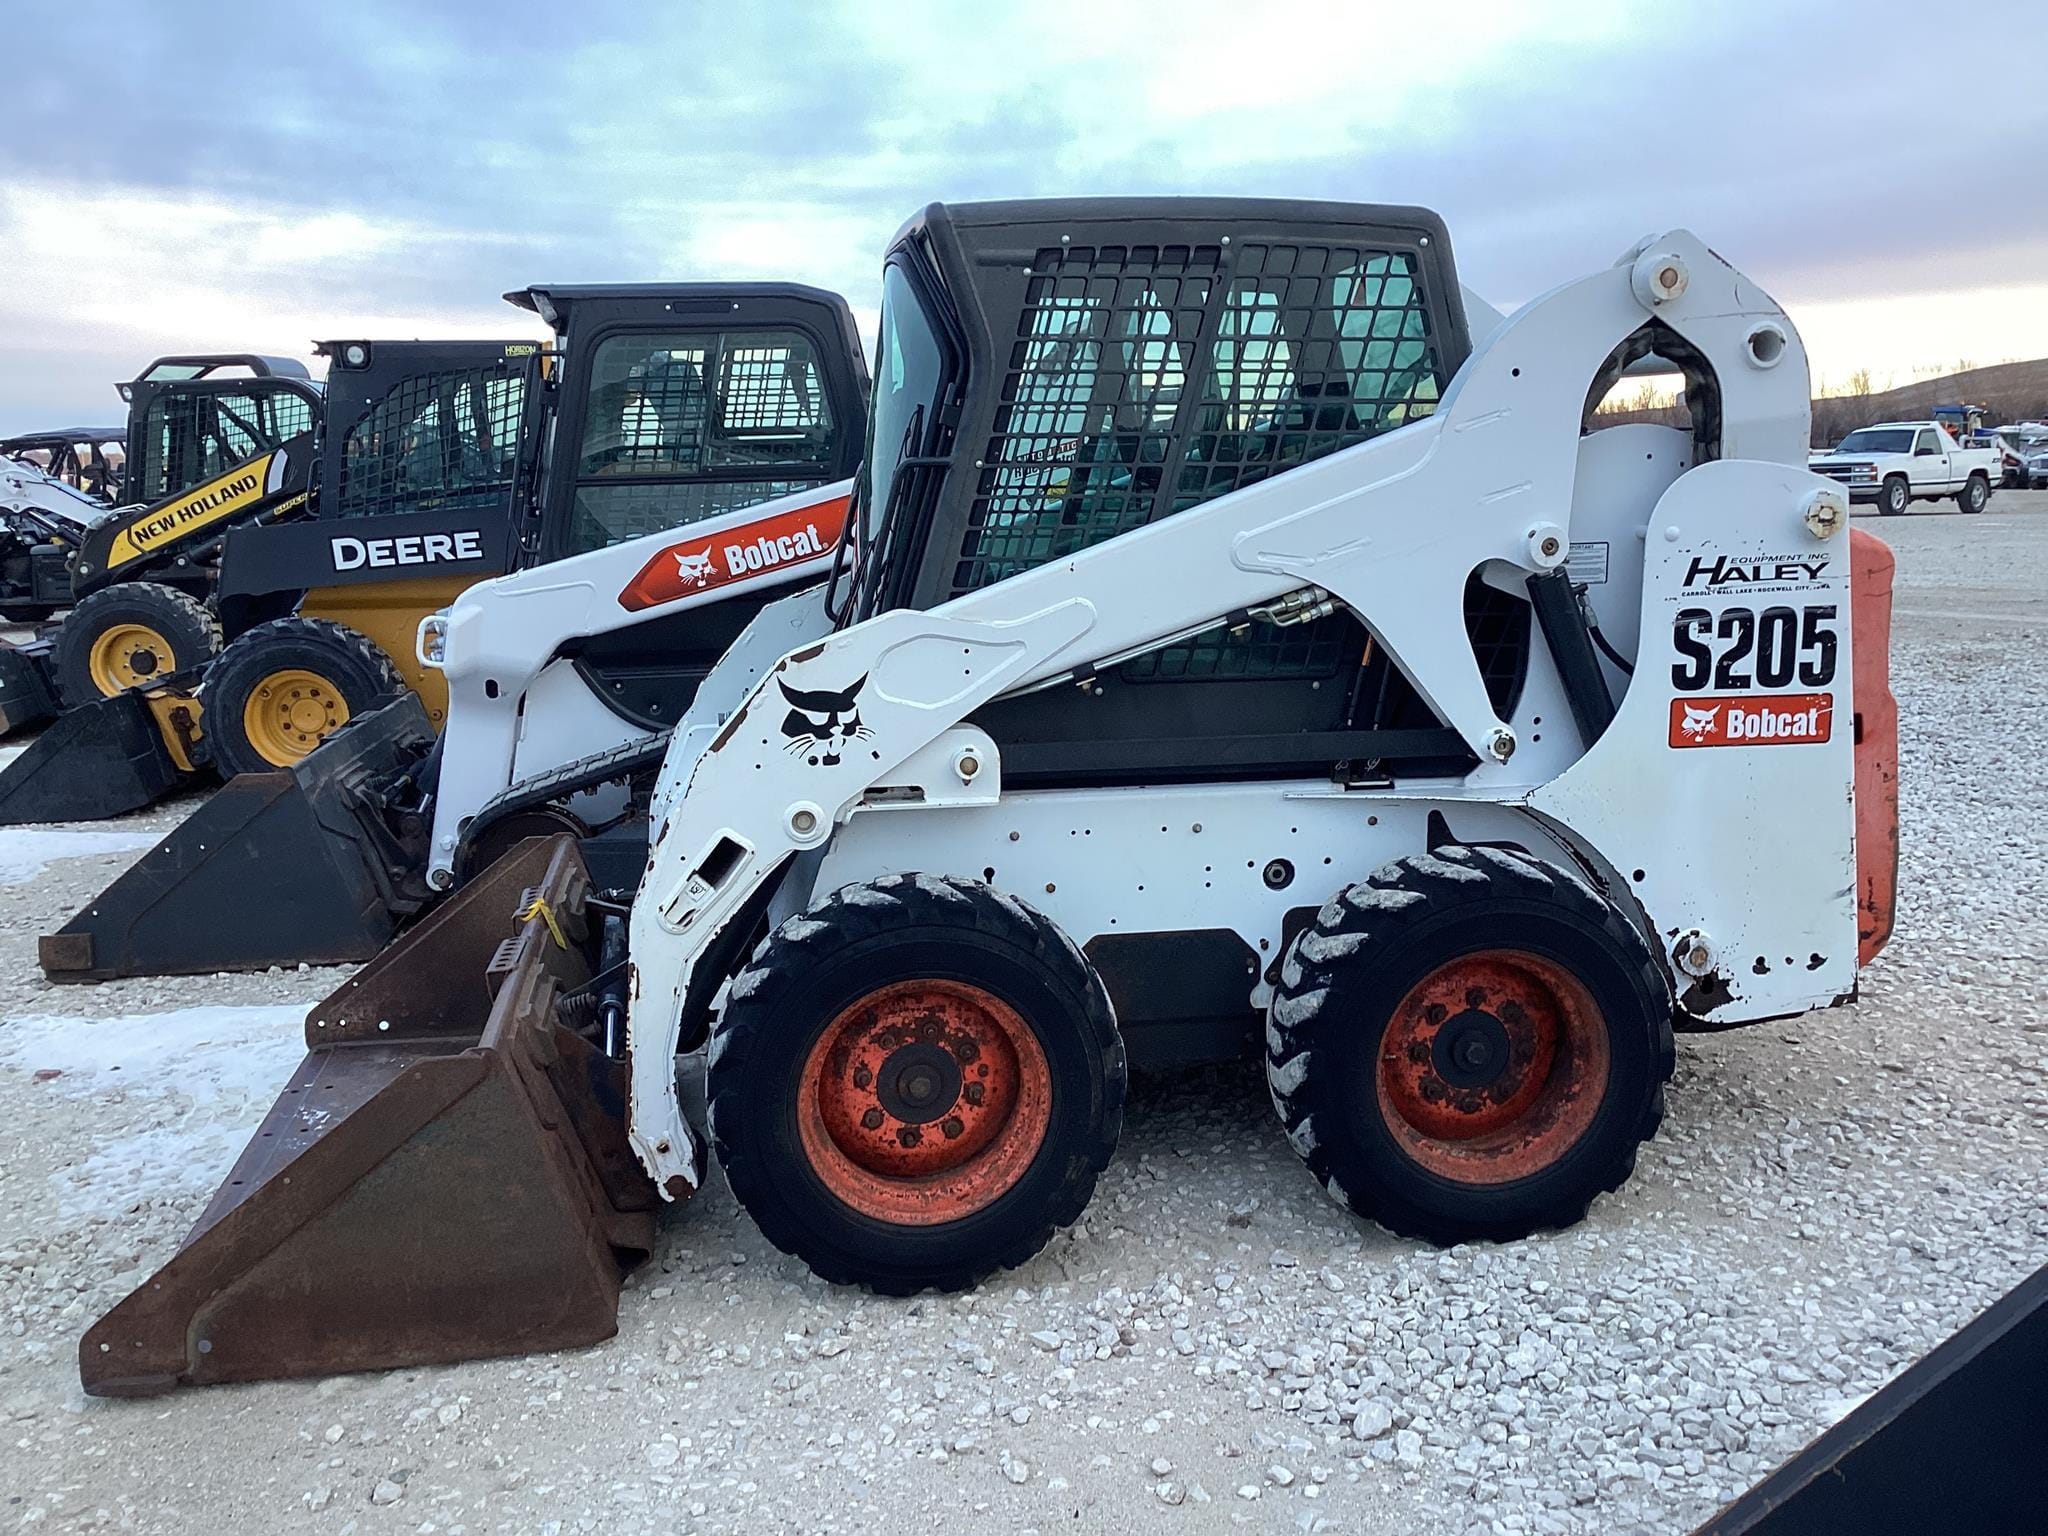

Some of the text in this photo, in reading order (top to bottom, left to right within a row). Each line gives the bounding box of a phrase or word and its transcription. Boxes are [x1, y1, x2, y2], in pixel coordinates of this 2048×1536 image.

[134, 474, 258, 543] NEW HOLLAND
[331, 531, 483, 571] DEERE
[723, 523, 823, 576] Bobcat
[1730, 552, 1831, 564] EQUIPMENT INC.
[1682, 555, 1830, 587] HALEY
[1681, 590, 1711, 598] CARROLL
[1671, 604, 1838, 691] S205
[1726, 707, 1818, 739] Bobcat
